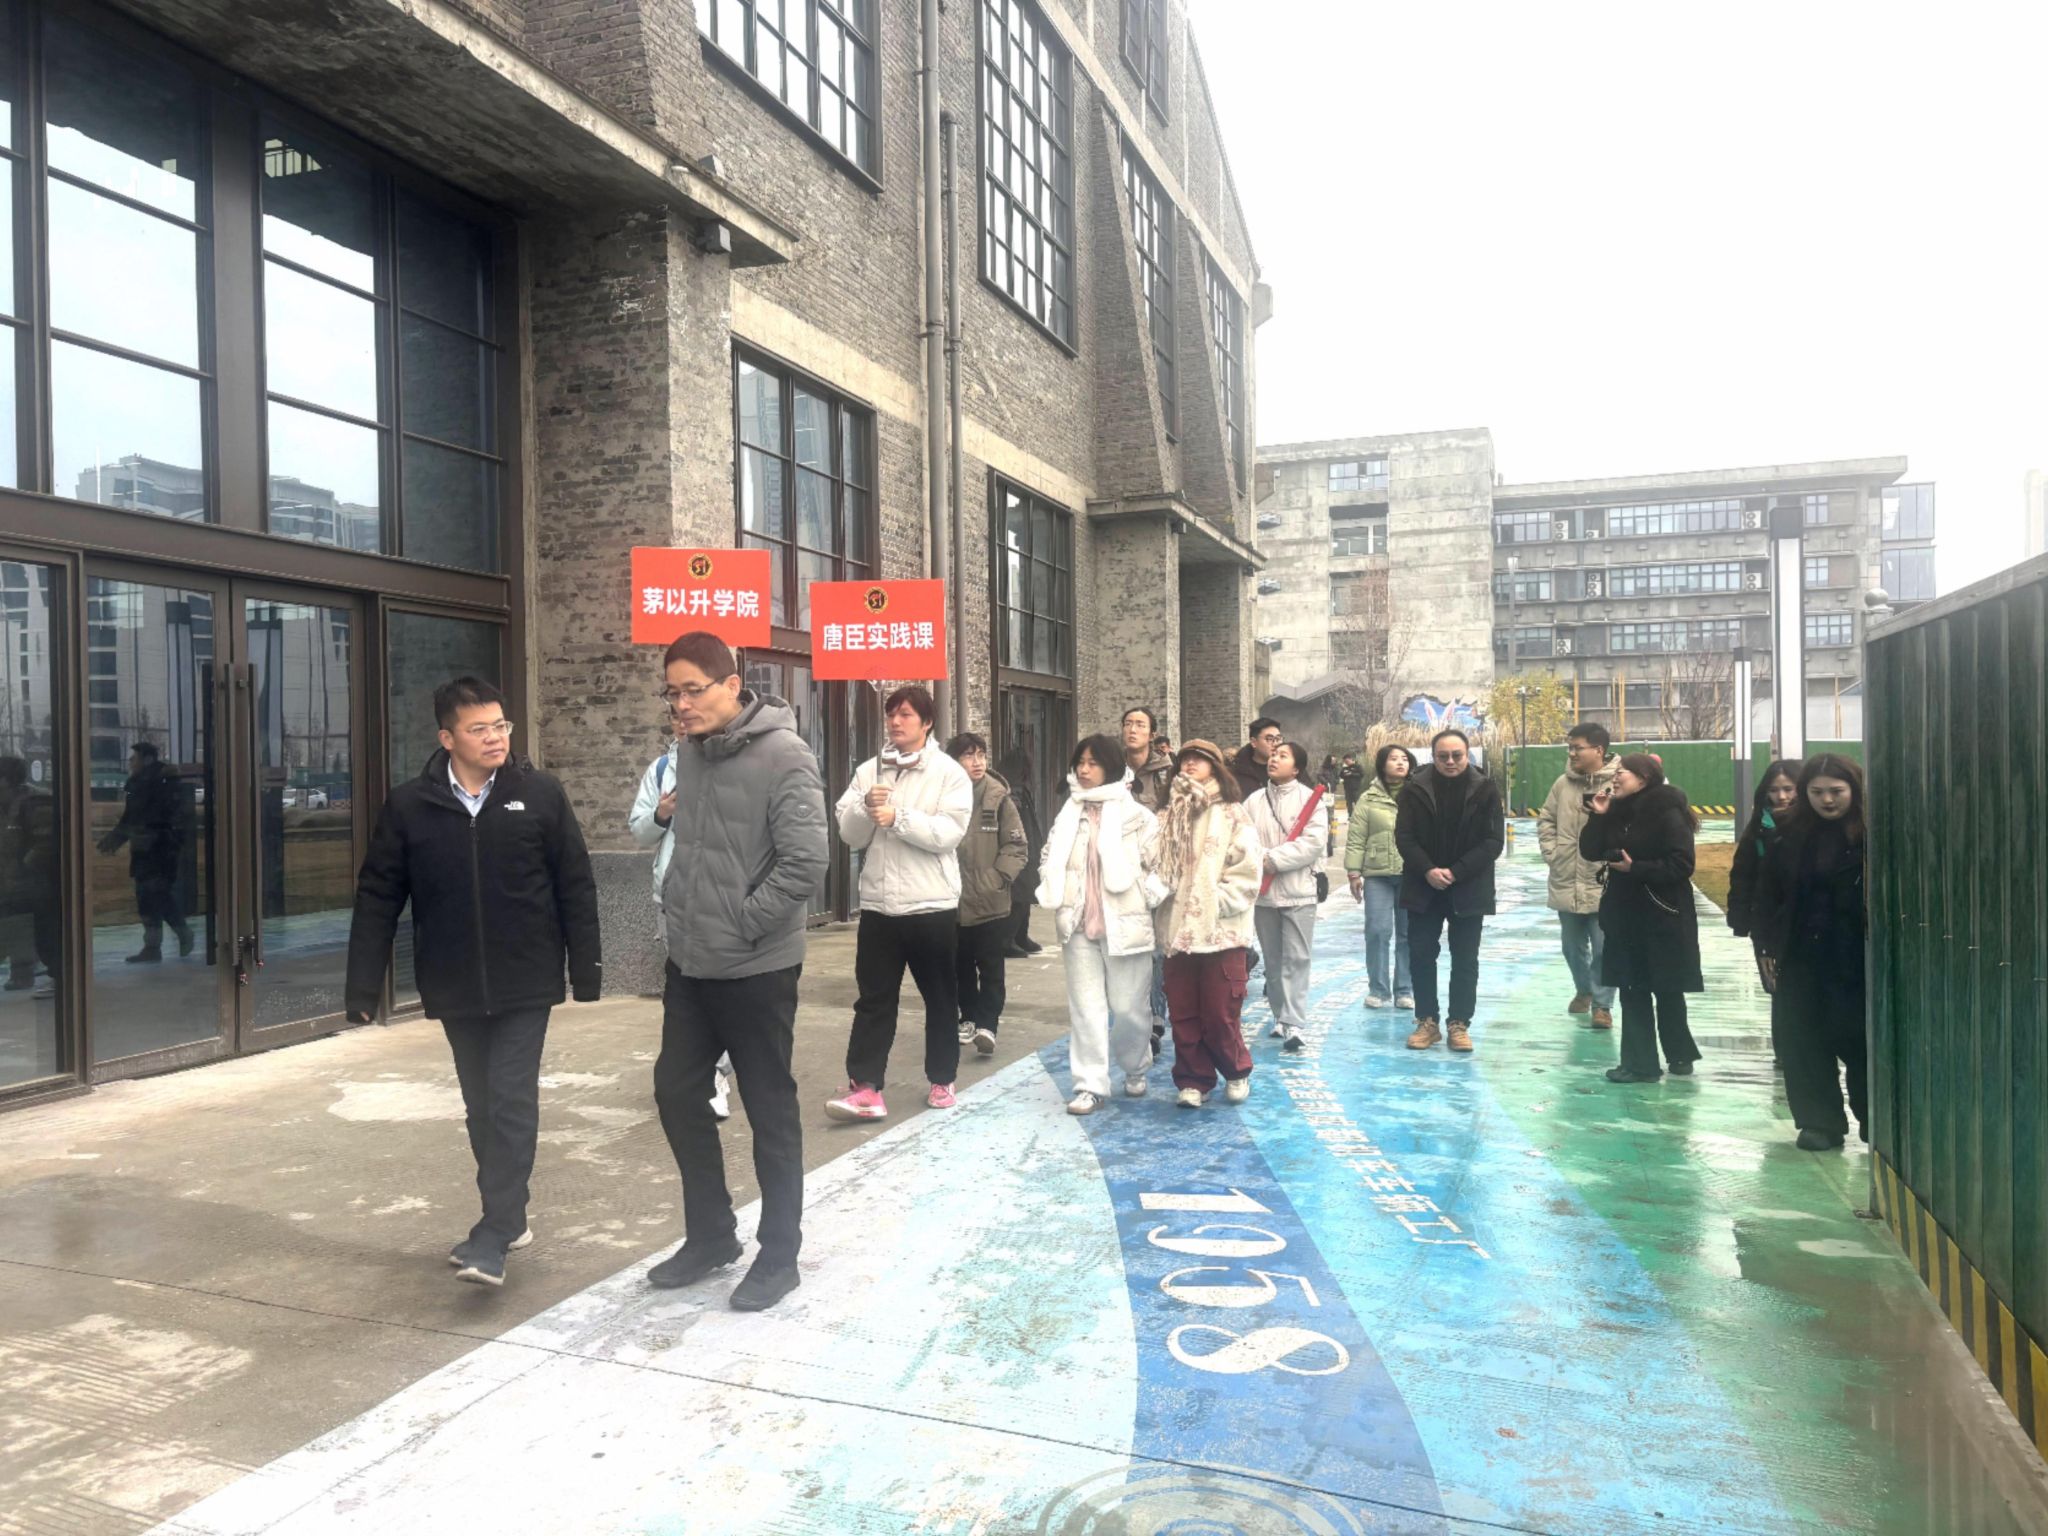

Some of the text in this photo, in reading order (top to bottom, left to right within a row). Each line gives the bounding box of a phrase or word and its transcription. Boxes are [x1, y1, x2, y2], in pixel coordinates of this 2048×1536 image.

[642, 587, 759, 618] 茅以升学院
[822, 621, 935, 651] 唐臣实践课
[1139, 1187, 1350, 1376] 1958
